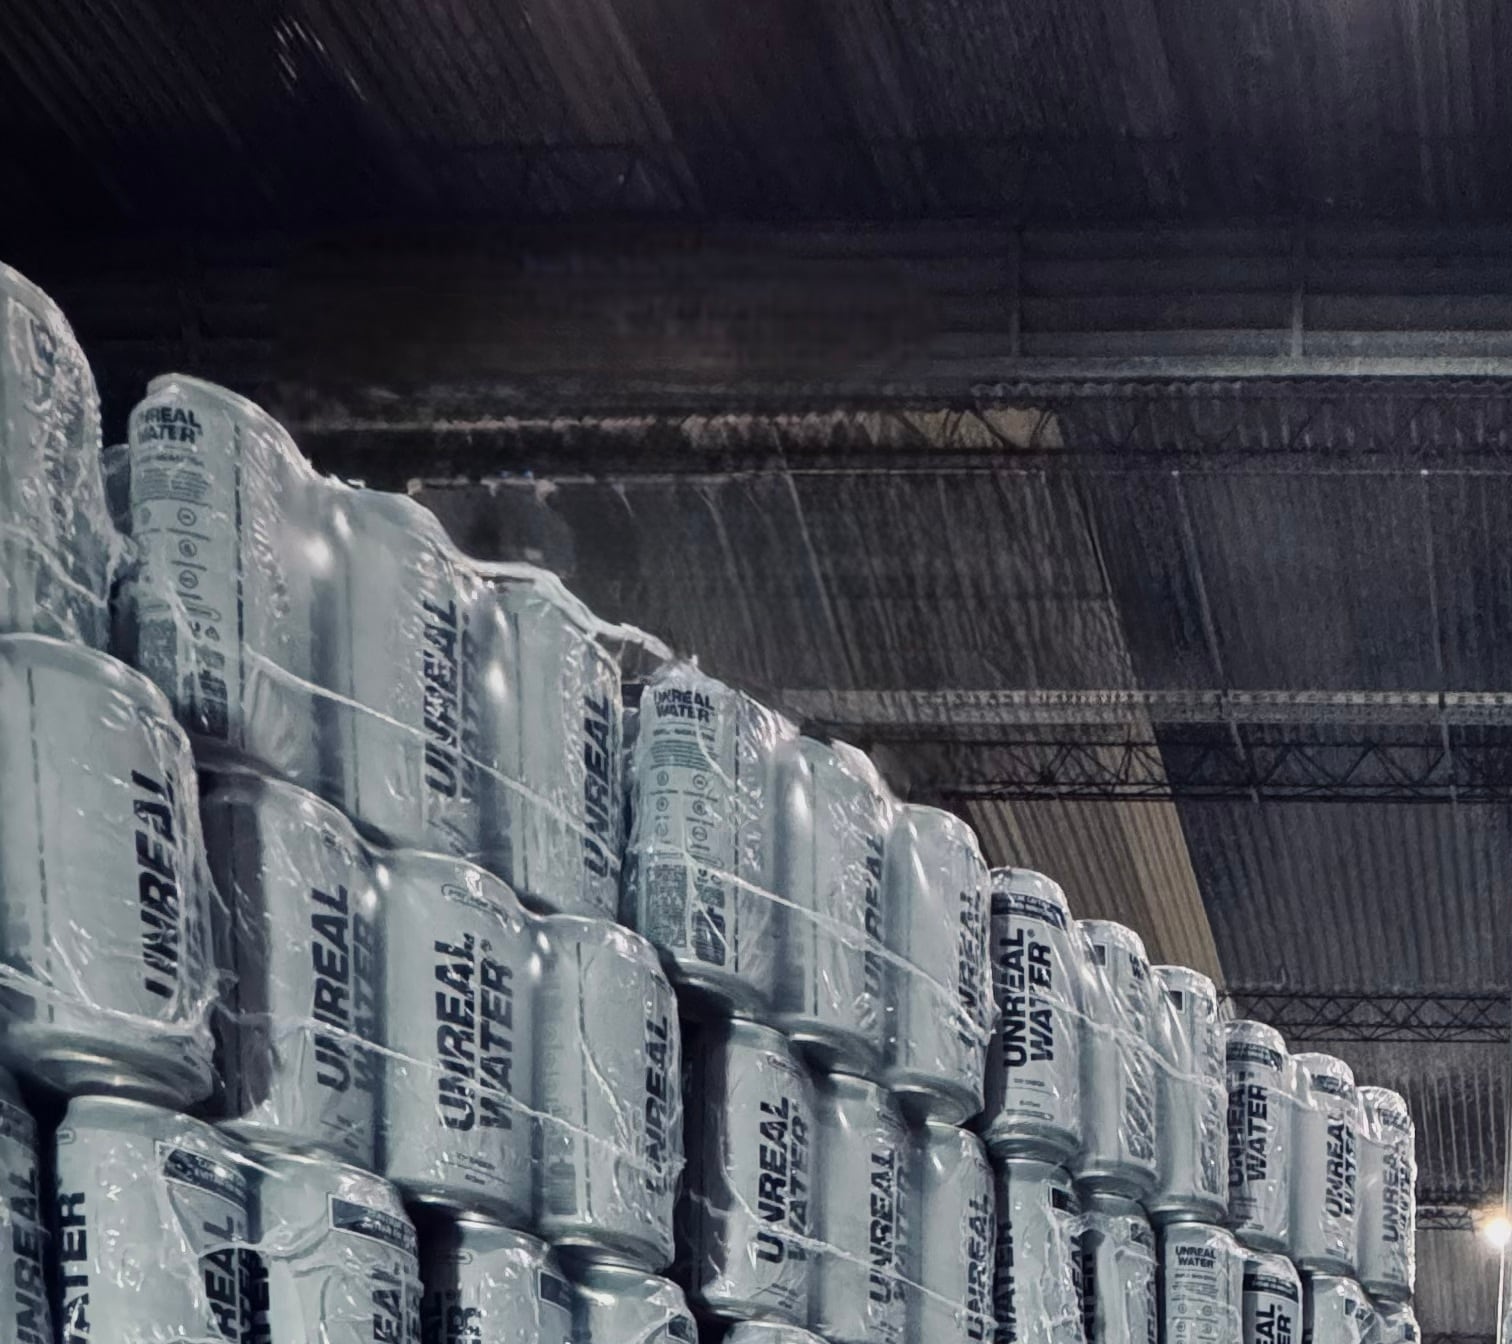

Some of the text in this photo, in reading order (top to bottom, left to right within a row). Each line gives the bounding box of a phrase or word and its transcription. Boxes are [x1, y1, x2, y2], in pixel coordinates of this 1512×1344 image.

[480, 965, 514, 1130] WATER
[1004, 928, 1024, 1067] UNREAL
[1028, 943, 1054, 1062] WATER
[1247, 1084, 1268, 1181] WATER
[1175, 1246, 1217, 1261] UNREAL
[1178, 1257, 1214, 1269] WATER
